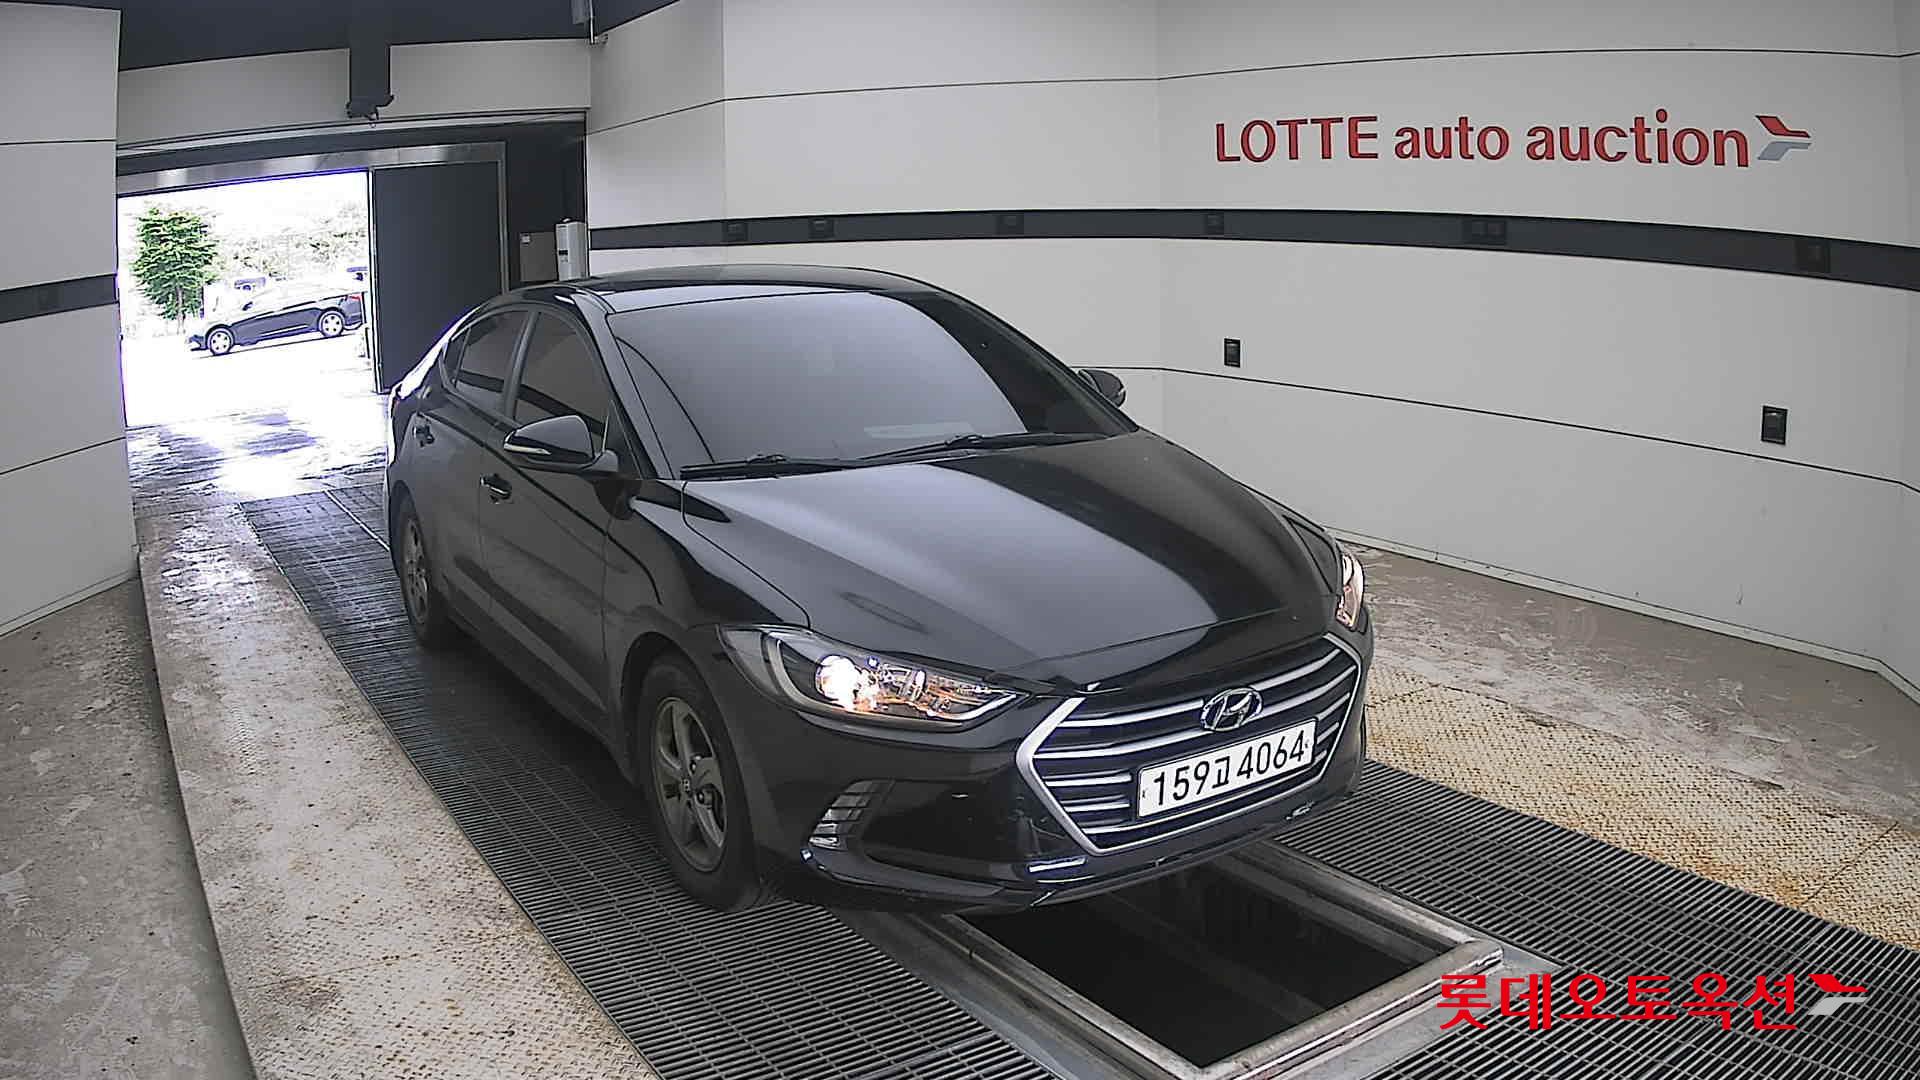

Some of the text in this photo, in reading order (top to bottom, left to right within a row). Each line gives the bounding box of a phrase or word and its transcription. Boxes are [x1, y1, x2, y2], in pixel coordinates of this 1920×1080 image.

[1215, 108, 1750, 168] LOTTE auto auction
